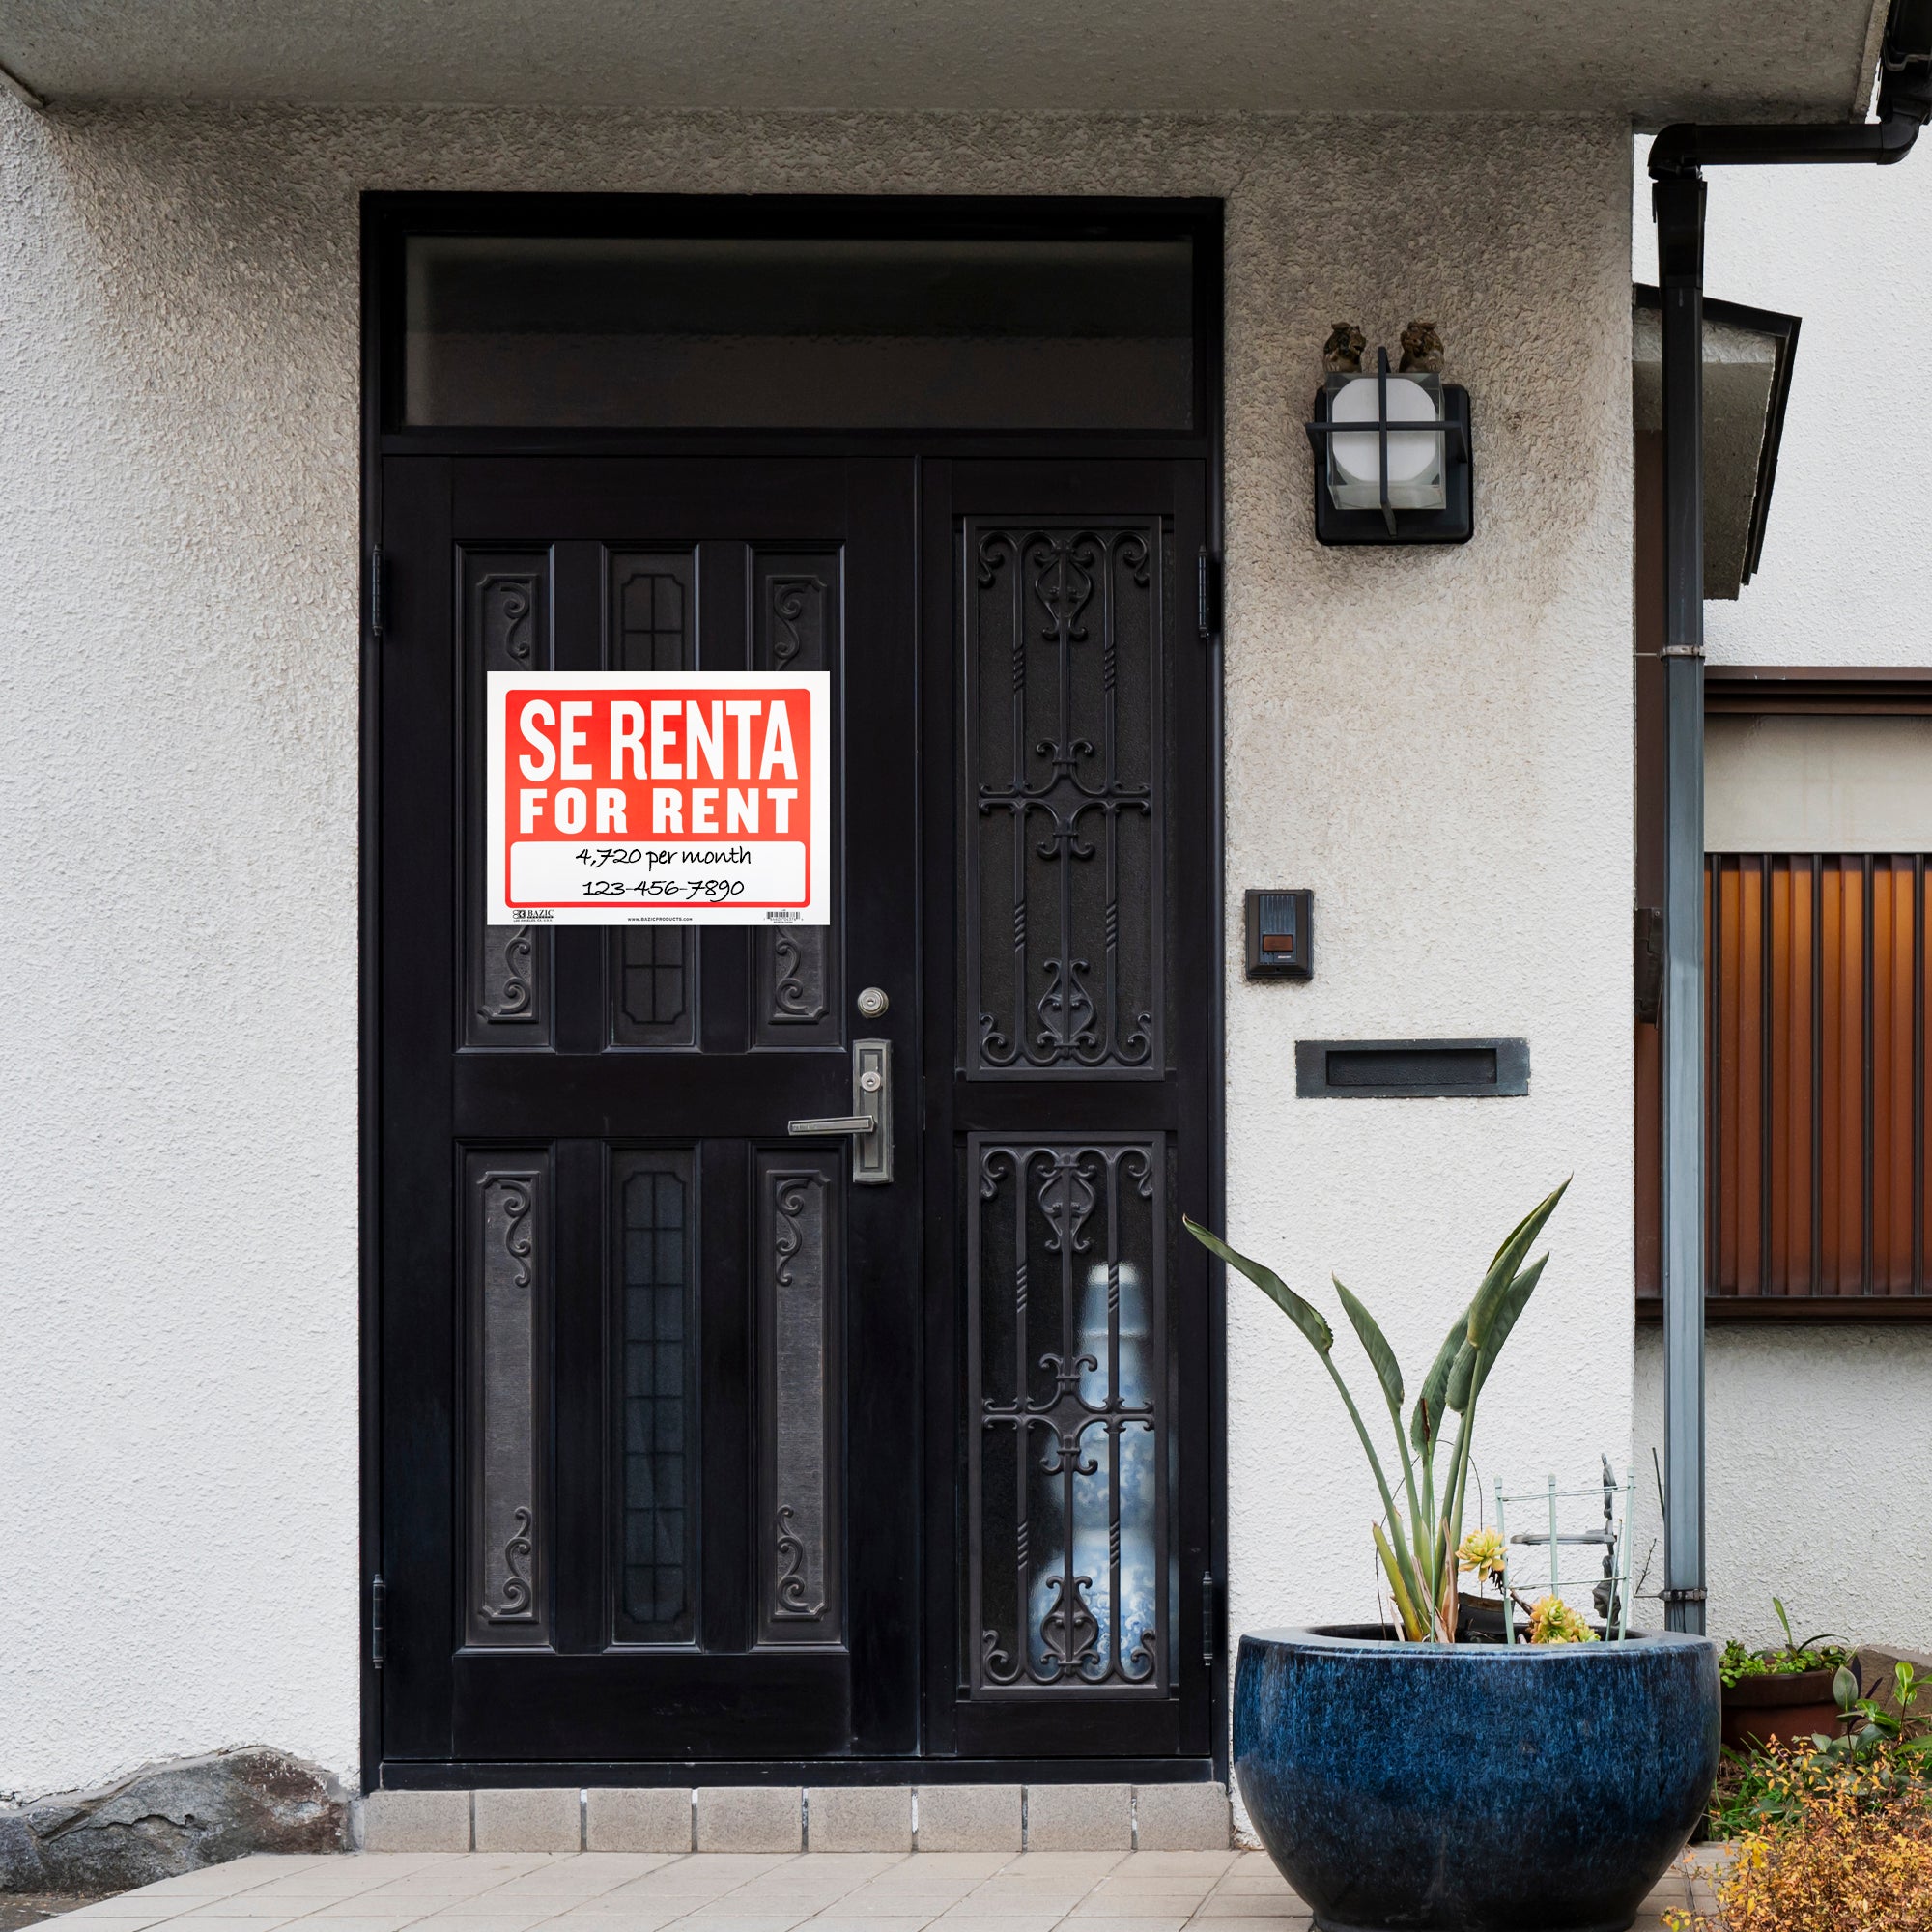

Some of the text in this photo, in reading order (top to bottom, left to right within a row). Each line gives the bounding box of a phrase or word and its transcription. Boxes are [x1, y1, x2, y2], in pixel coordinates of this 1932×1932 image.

[519, 698, 799, 782] SE RENTA
[519, 787, 798, 835] FOR RENT
[575, 845, 752, 872] 4,720 per month
[582, 879, 745, 902] 123-456-7890
